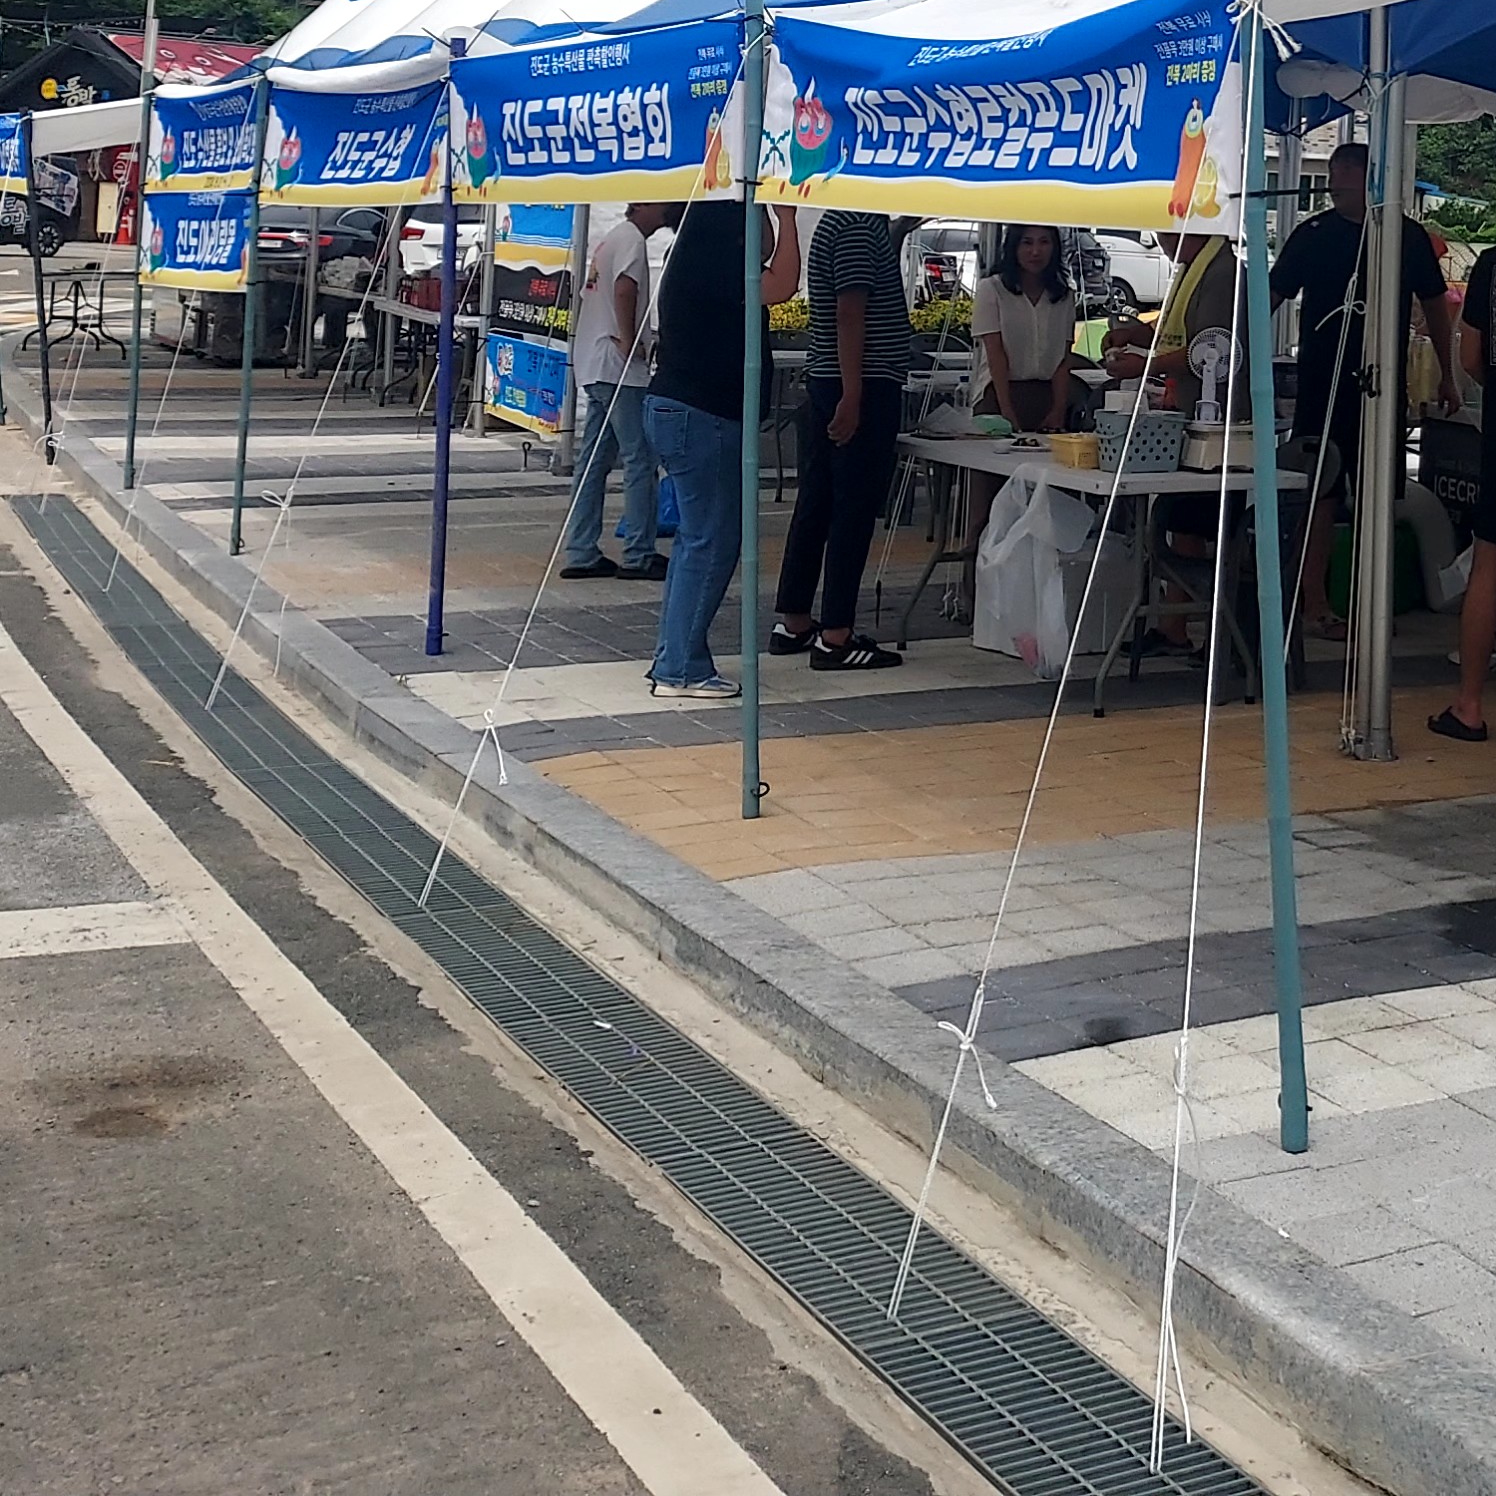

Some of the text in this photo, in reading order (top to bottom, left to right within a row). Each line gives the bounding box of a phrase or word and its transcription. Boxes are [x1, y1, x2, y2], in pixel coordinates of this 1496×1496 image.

[1155, 20, 1180, 35] 전복
[1174, 15, 1197, 31] 무료
[530, 41, 630, 77] 진도군 농수특산물 판촉할인행사
[1166, 59, 1216, 86] 전복 2마리 증정
[502, 82, 672, 165] 진도군전복협회
[845, 62, 1147, 172] 진도군수협로컬푸드마켓
[319, 124, 416, 180] 진도군수협
